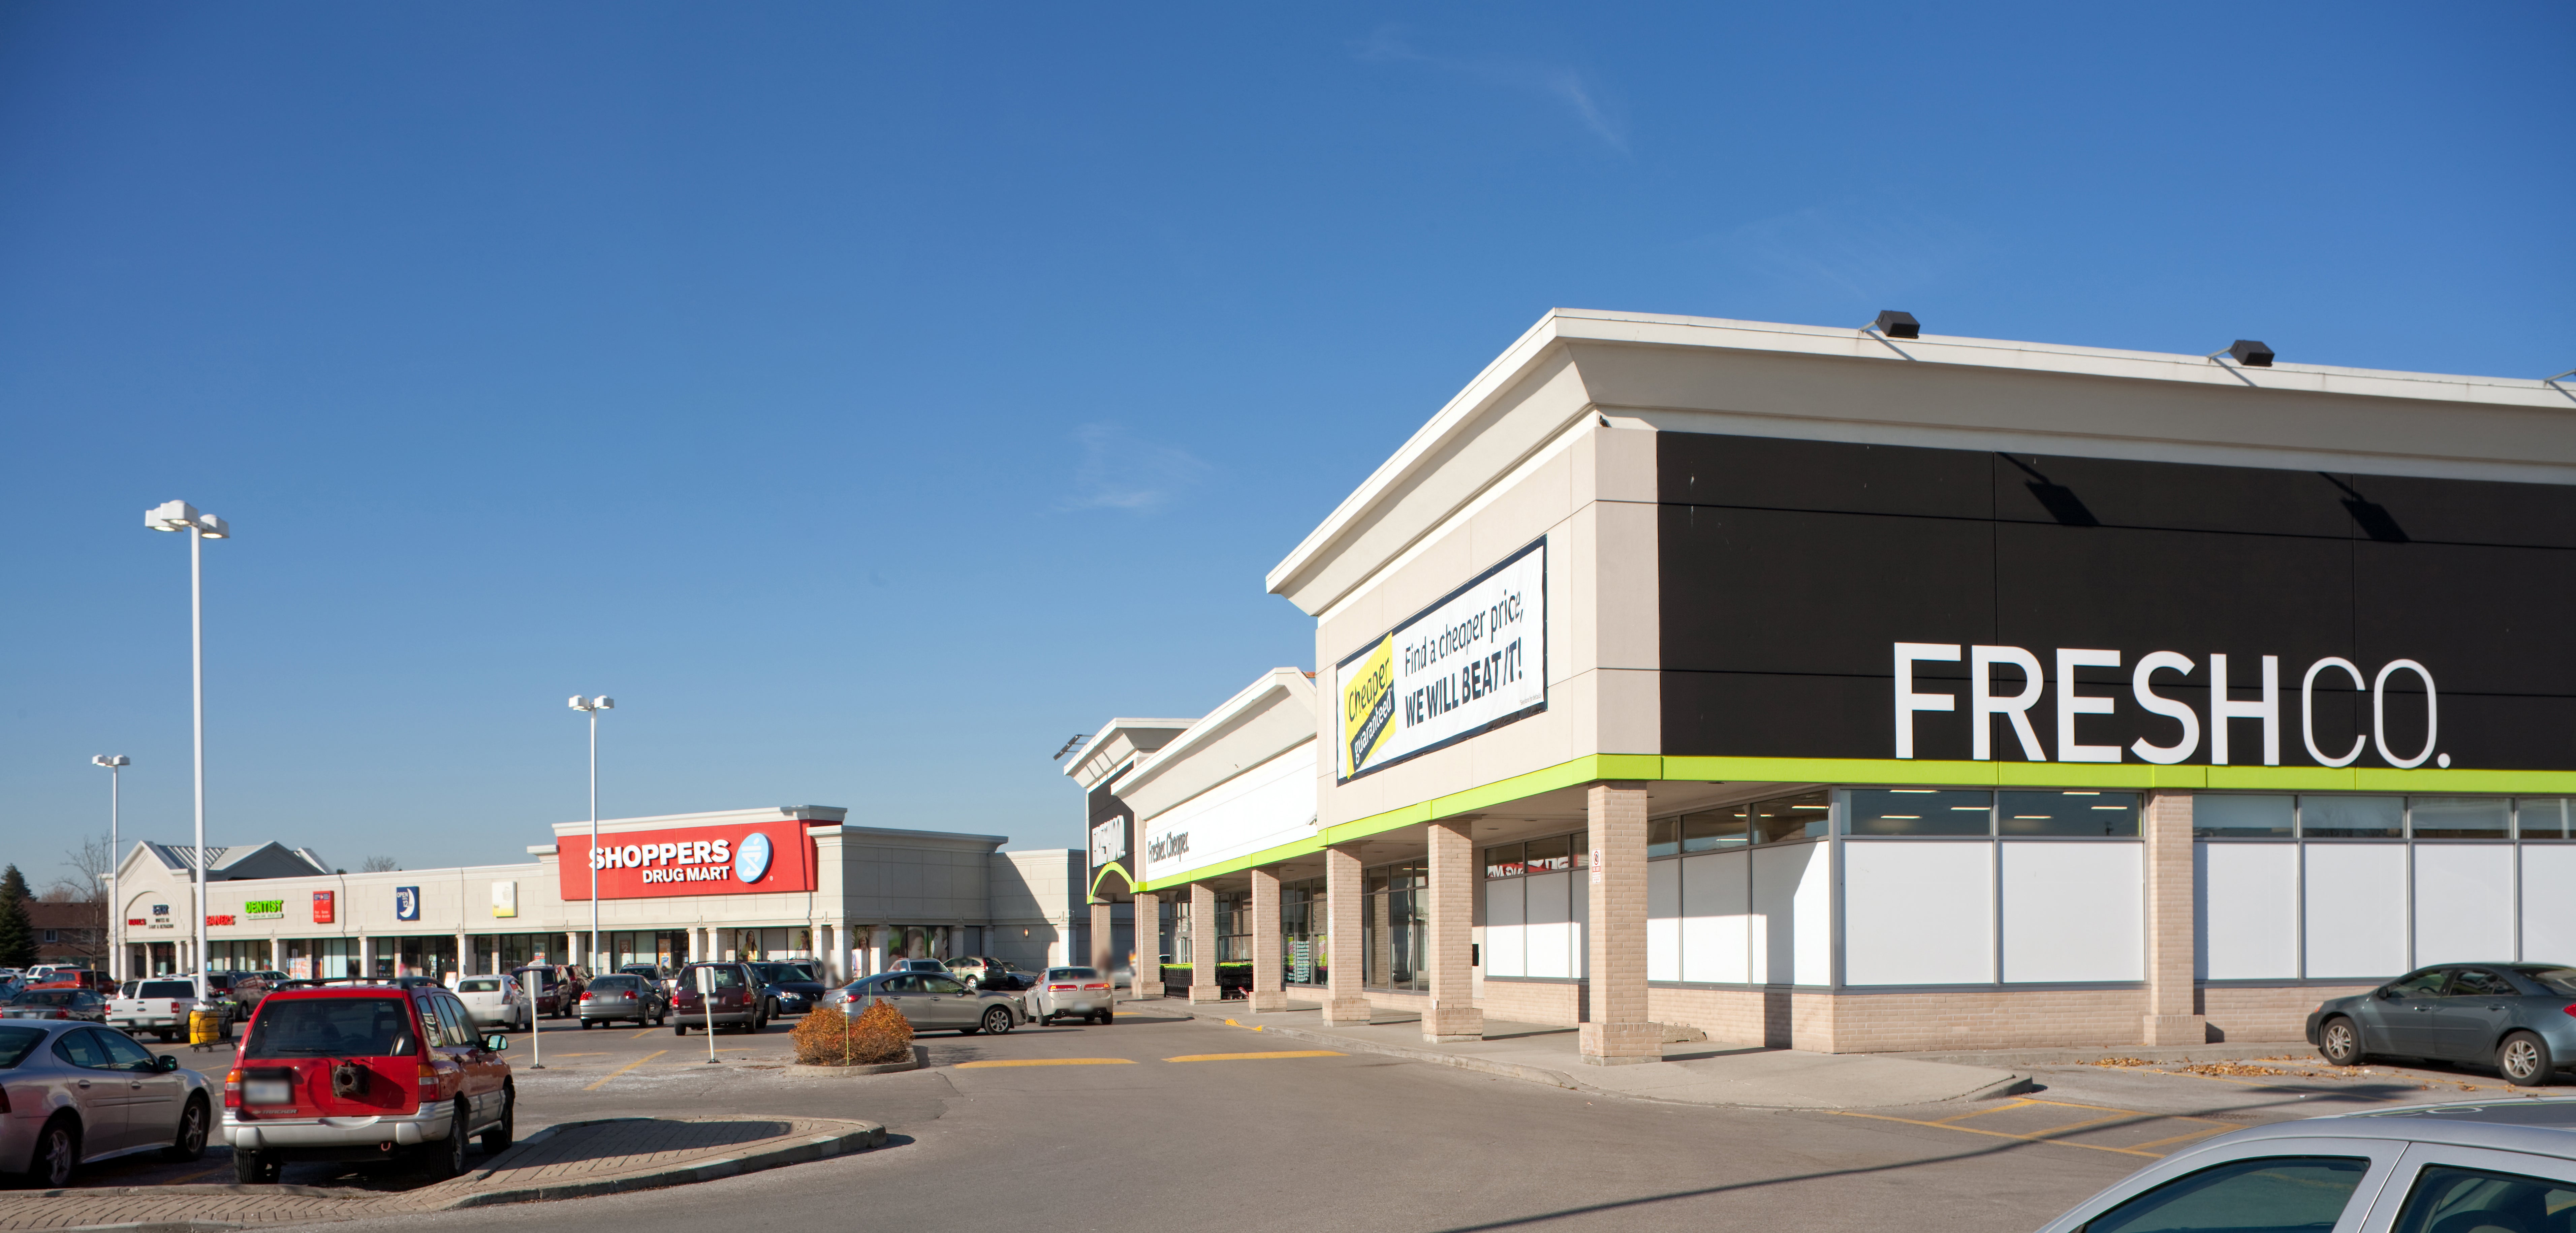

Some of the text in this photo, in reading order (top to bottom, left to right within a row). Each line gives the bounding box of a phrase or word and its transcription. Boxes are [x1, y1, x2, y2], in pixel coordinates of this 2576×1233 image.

[1406, 589, 1523, 677] Find a cheaper price,
[1349, 657, 1389, 722] Cheaper
[1405, 687, 1424, 729] WE
[1426, 673, 1459, 719] WILL
[1462, 650, 1501, 705] BEAT
[589, 839, 730, 870] SHOPPERS
[1148, 831, 1189, 864] Fresher. Cheaper.
[642, 866, 730, 883] DRUG MART
[206, 915, 235, 926] EANERS
[246, 900, 283, 914] DENTIST
